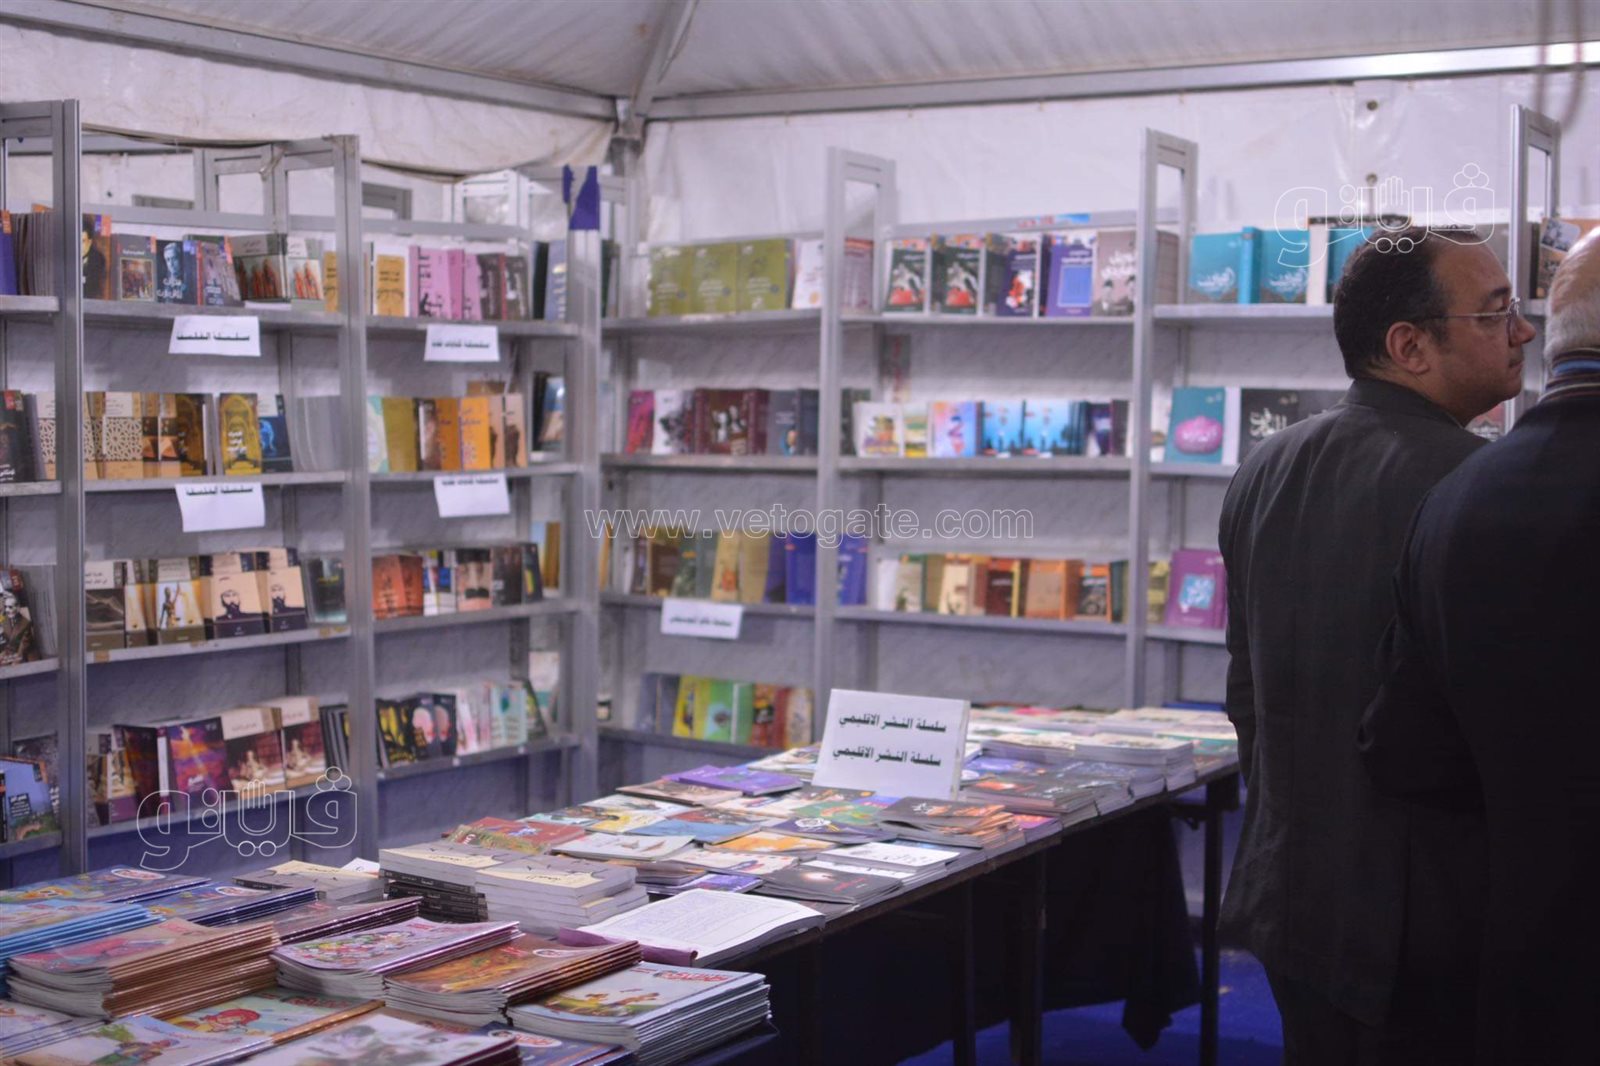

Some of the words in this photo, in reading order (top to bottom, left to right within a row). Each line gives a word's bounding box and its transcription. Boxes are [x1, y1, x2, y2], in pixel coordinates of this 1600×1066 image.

[880, 715, 913, 730] النشر
[915, 719, 947, 732] سلسلة
[875, 748, 908, 763] النشر
[910, 751, 942, 766] سلسلة
